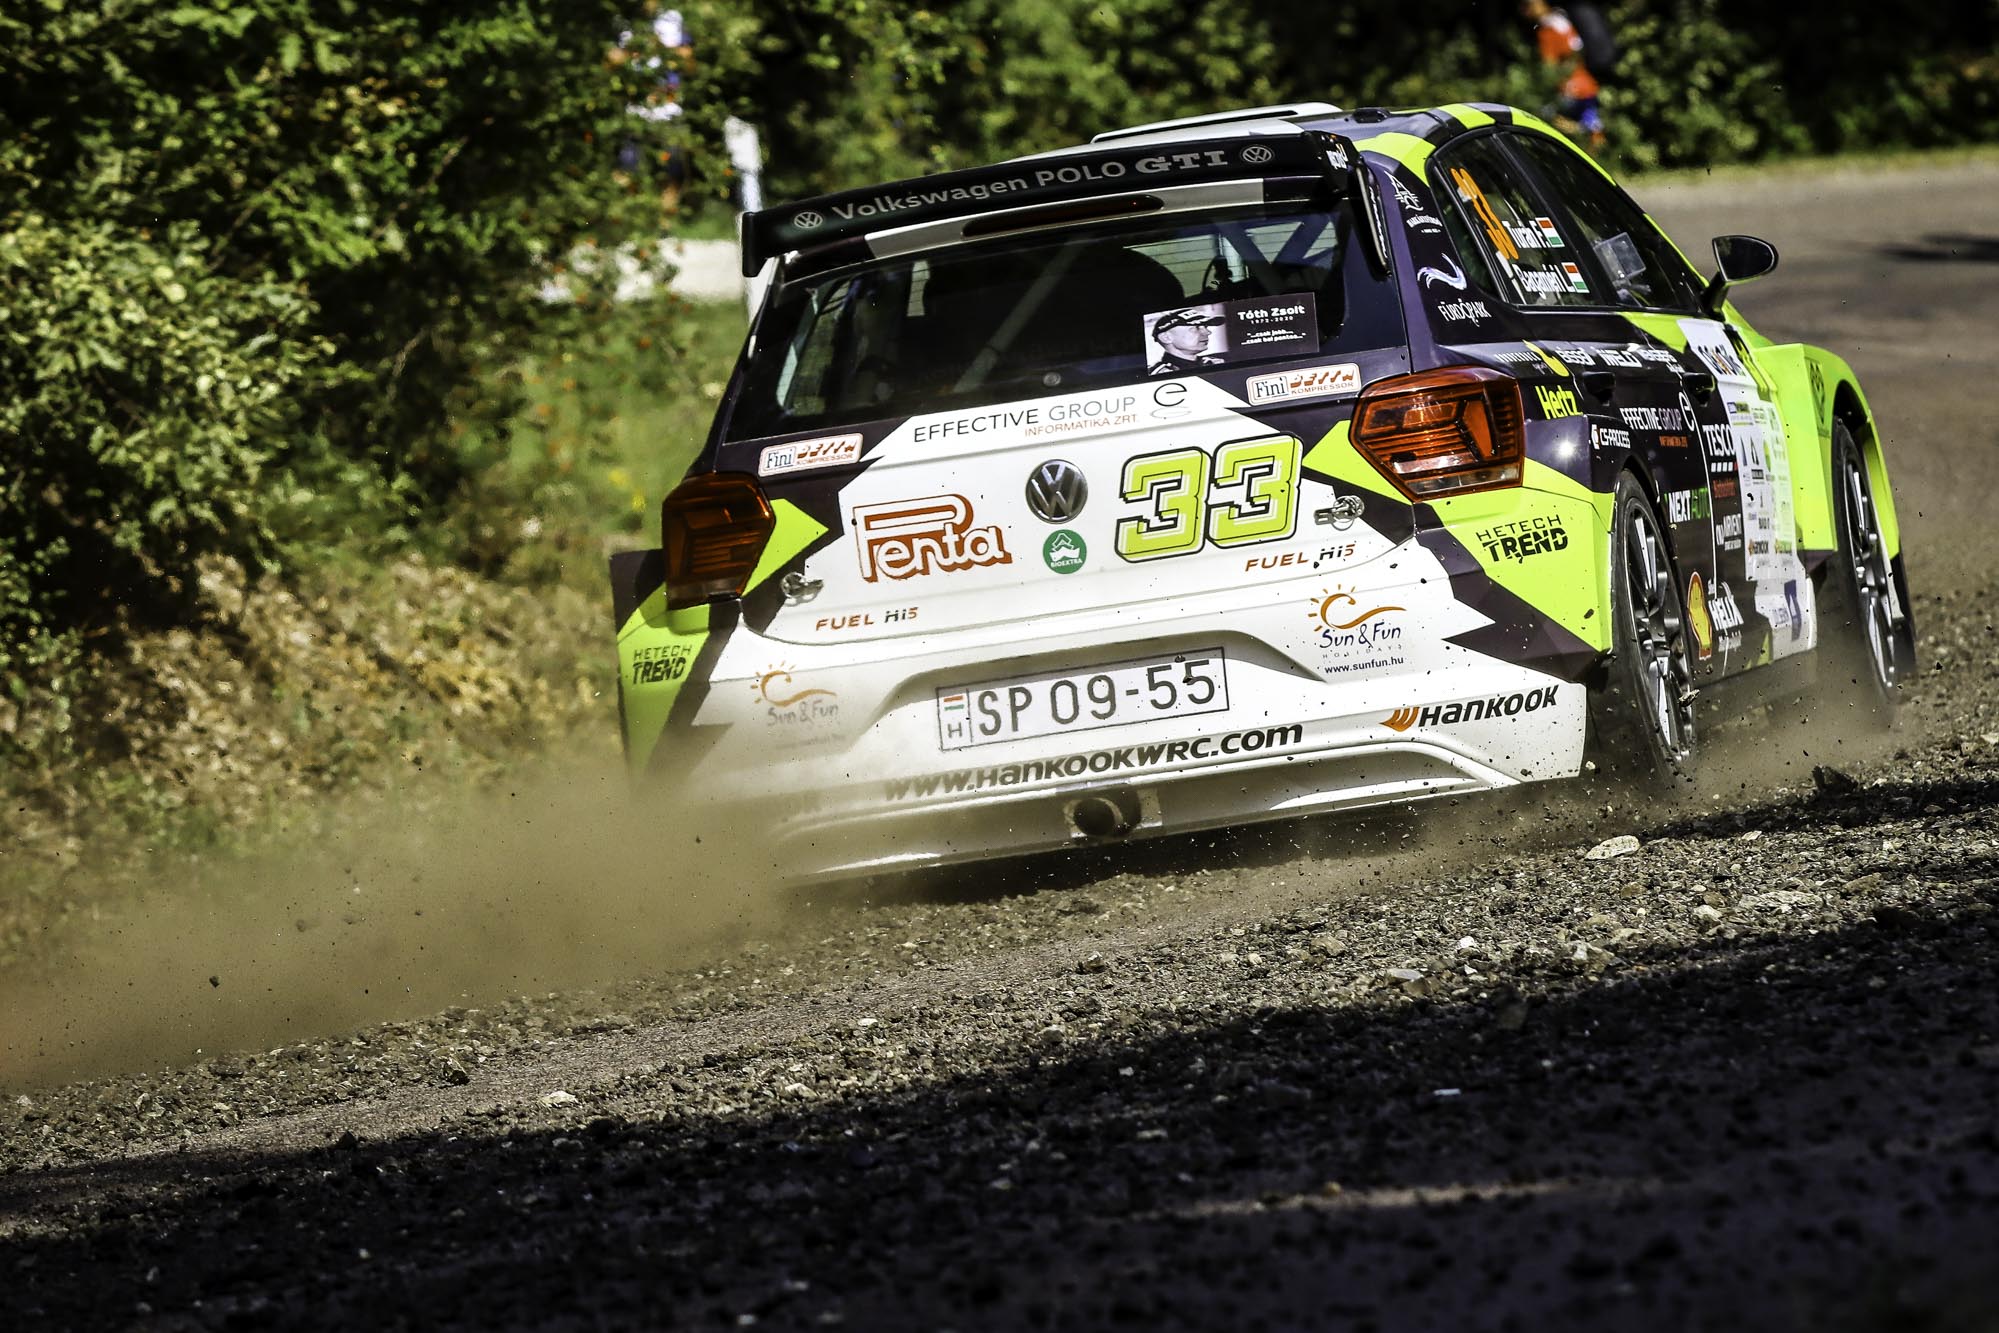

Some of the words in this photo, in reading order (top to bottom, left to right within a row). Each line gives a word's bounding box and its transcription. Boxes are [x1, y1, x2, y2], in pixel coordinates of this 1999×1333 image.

[832, 176, 1029, 221] Volkswagen
[1036, 160, 1127, 188] POLO
[1134, 150, 1229, 175] GTI
[1237, 309, 1268, 320] Tóth
[1270, 305, 1306, 317] Zsolt
[1254, 377, 1285, 398] Fini
[1291, 382, 1354, 395] KOMPRESSOR
[914, 408, 1039, 442] EFFECTIVE
[1049, 396, 1136, 422] GROUP
[1024, 418, 1110, 437] INFORMATIKA
[1619, 407, 1662, 430] EFFECTIVE
[1702, 423, 1736, 456] TESCO
[766, 448, 792, 468] Fini
[1115, 431, 1303, 563] 33
[853, 494, 1012, 583] Penta
[1475, 514, 1562, 541] HETECH
[1482, 527, 1568, 563] TREND
[1245, 552, 1310, 572] FUEL
[816, 614, 875, 631] FUEL
[1320, 628, 1354, 649] Sun
[1372, 621, 1401, 642] Fun
[634, 644, 692, 660] HETECH
[633, 656, 687, 684] TREND
[1324, 656, 1404, 674] www.sunfun.hu
[947, 721, 963, 739] H
[979, 687, 1033, 736] SP
[1050, 659, 1215, 725] 09-55
